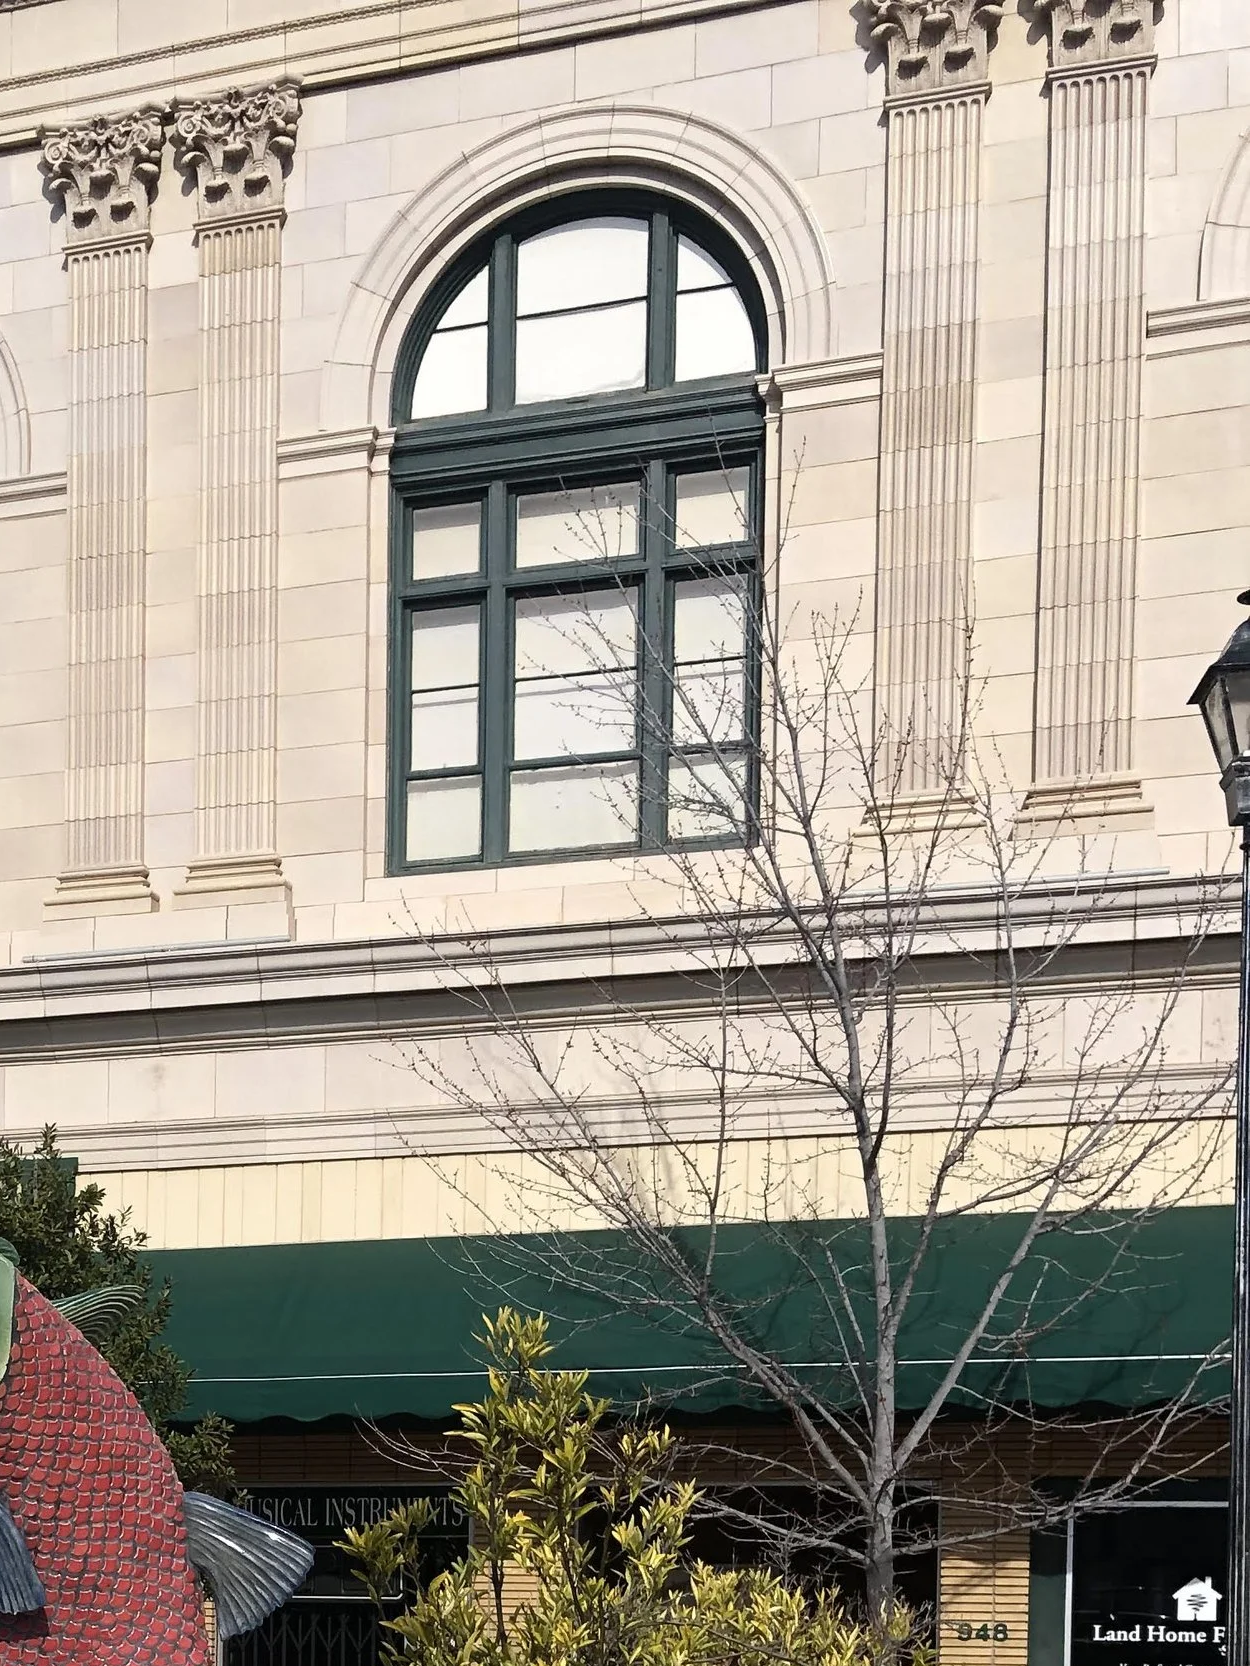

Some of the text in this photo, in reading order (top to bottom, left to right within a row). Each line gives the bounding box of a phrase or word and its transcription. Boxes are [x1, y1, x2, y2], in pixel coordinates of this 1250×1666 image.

[957, 1622, 1008, 1642] 948
[1093, 1624, 1141, 1643] Land
[1147, 1625, 1207, 1643] Home
